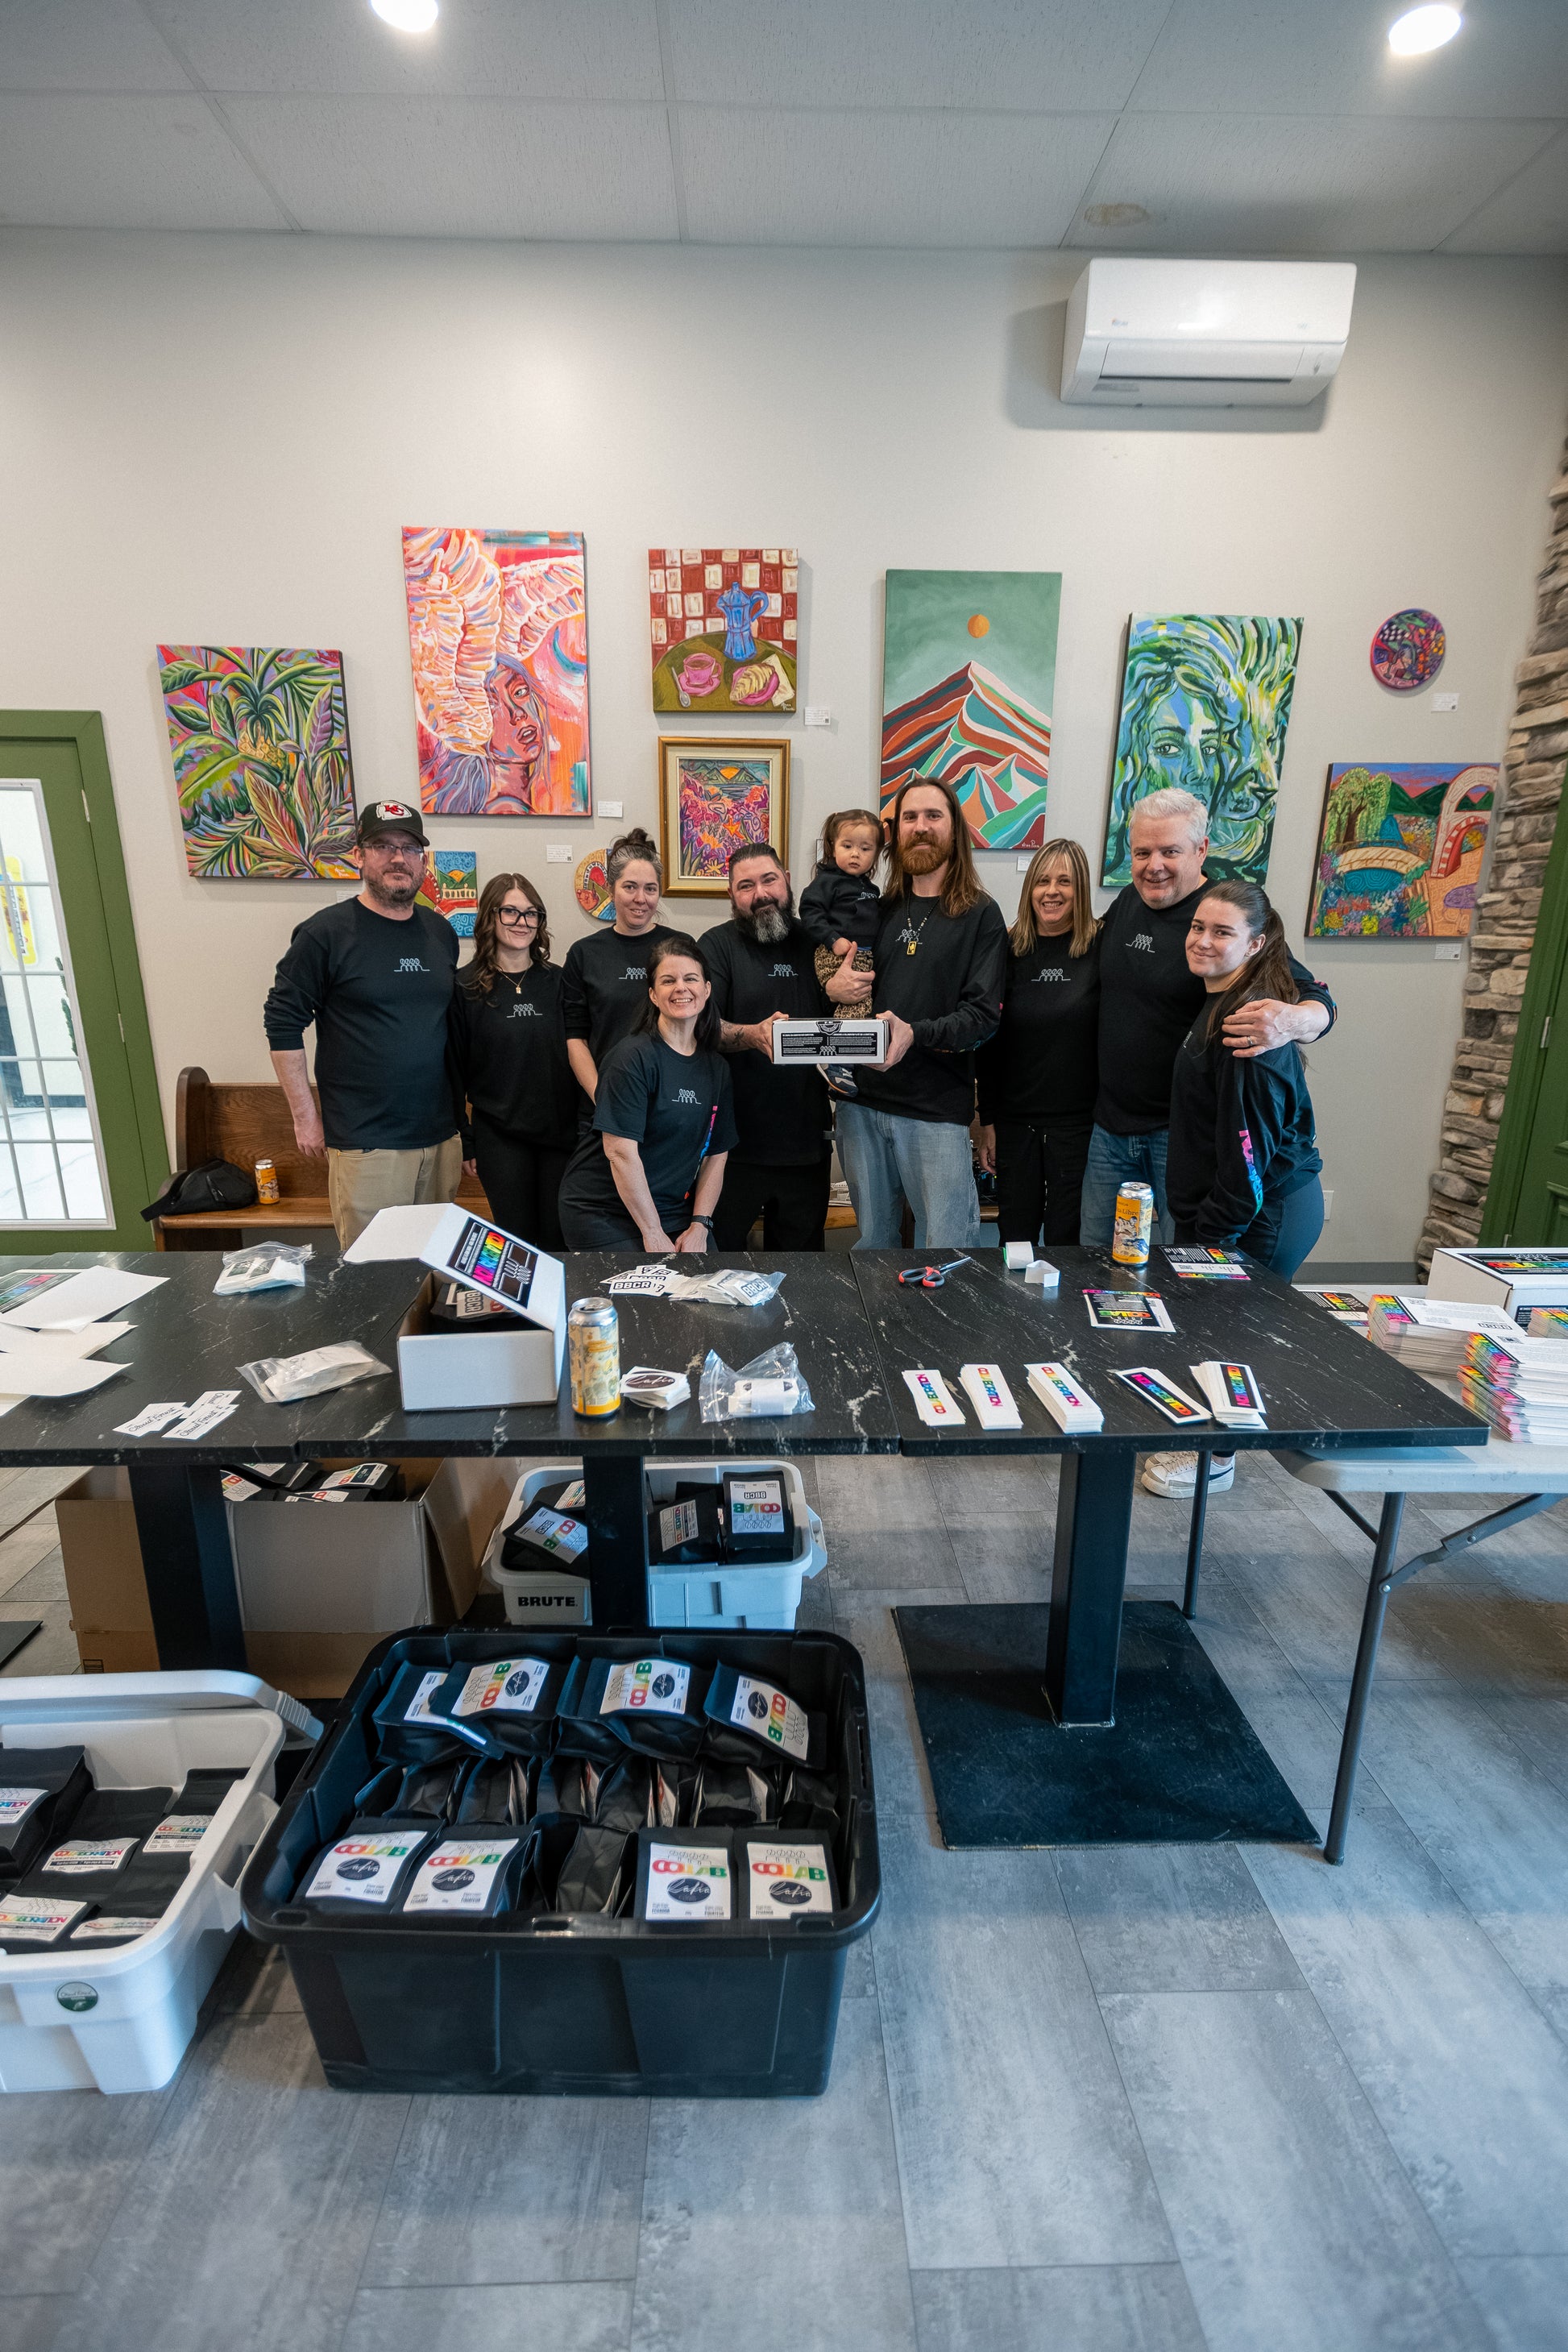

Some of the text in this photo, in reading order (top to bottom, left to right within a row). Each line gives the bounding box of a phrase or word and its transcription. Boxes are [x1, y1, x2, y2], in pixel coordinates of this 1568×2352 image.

[613, 1281, 651, 1290] BBCR
[745, 1491, 766, 1500] BBCR
[518, 1596, 575, 1607] BRUTE
